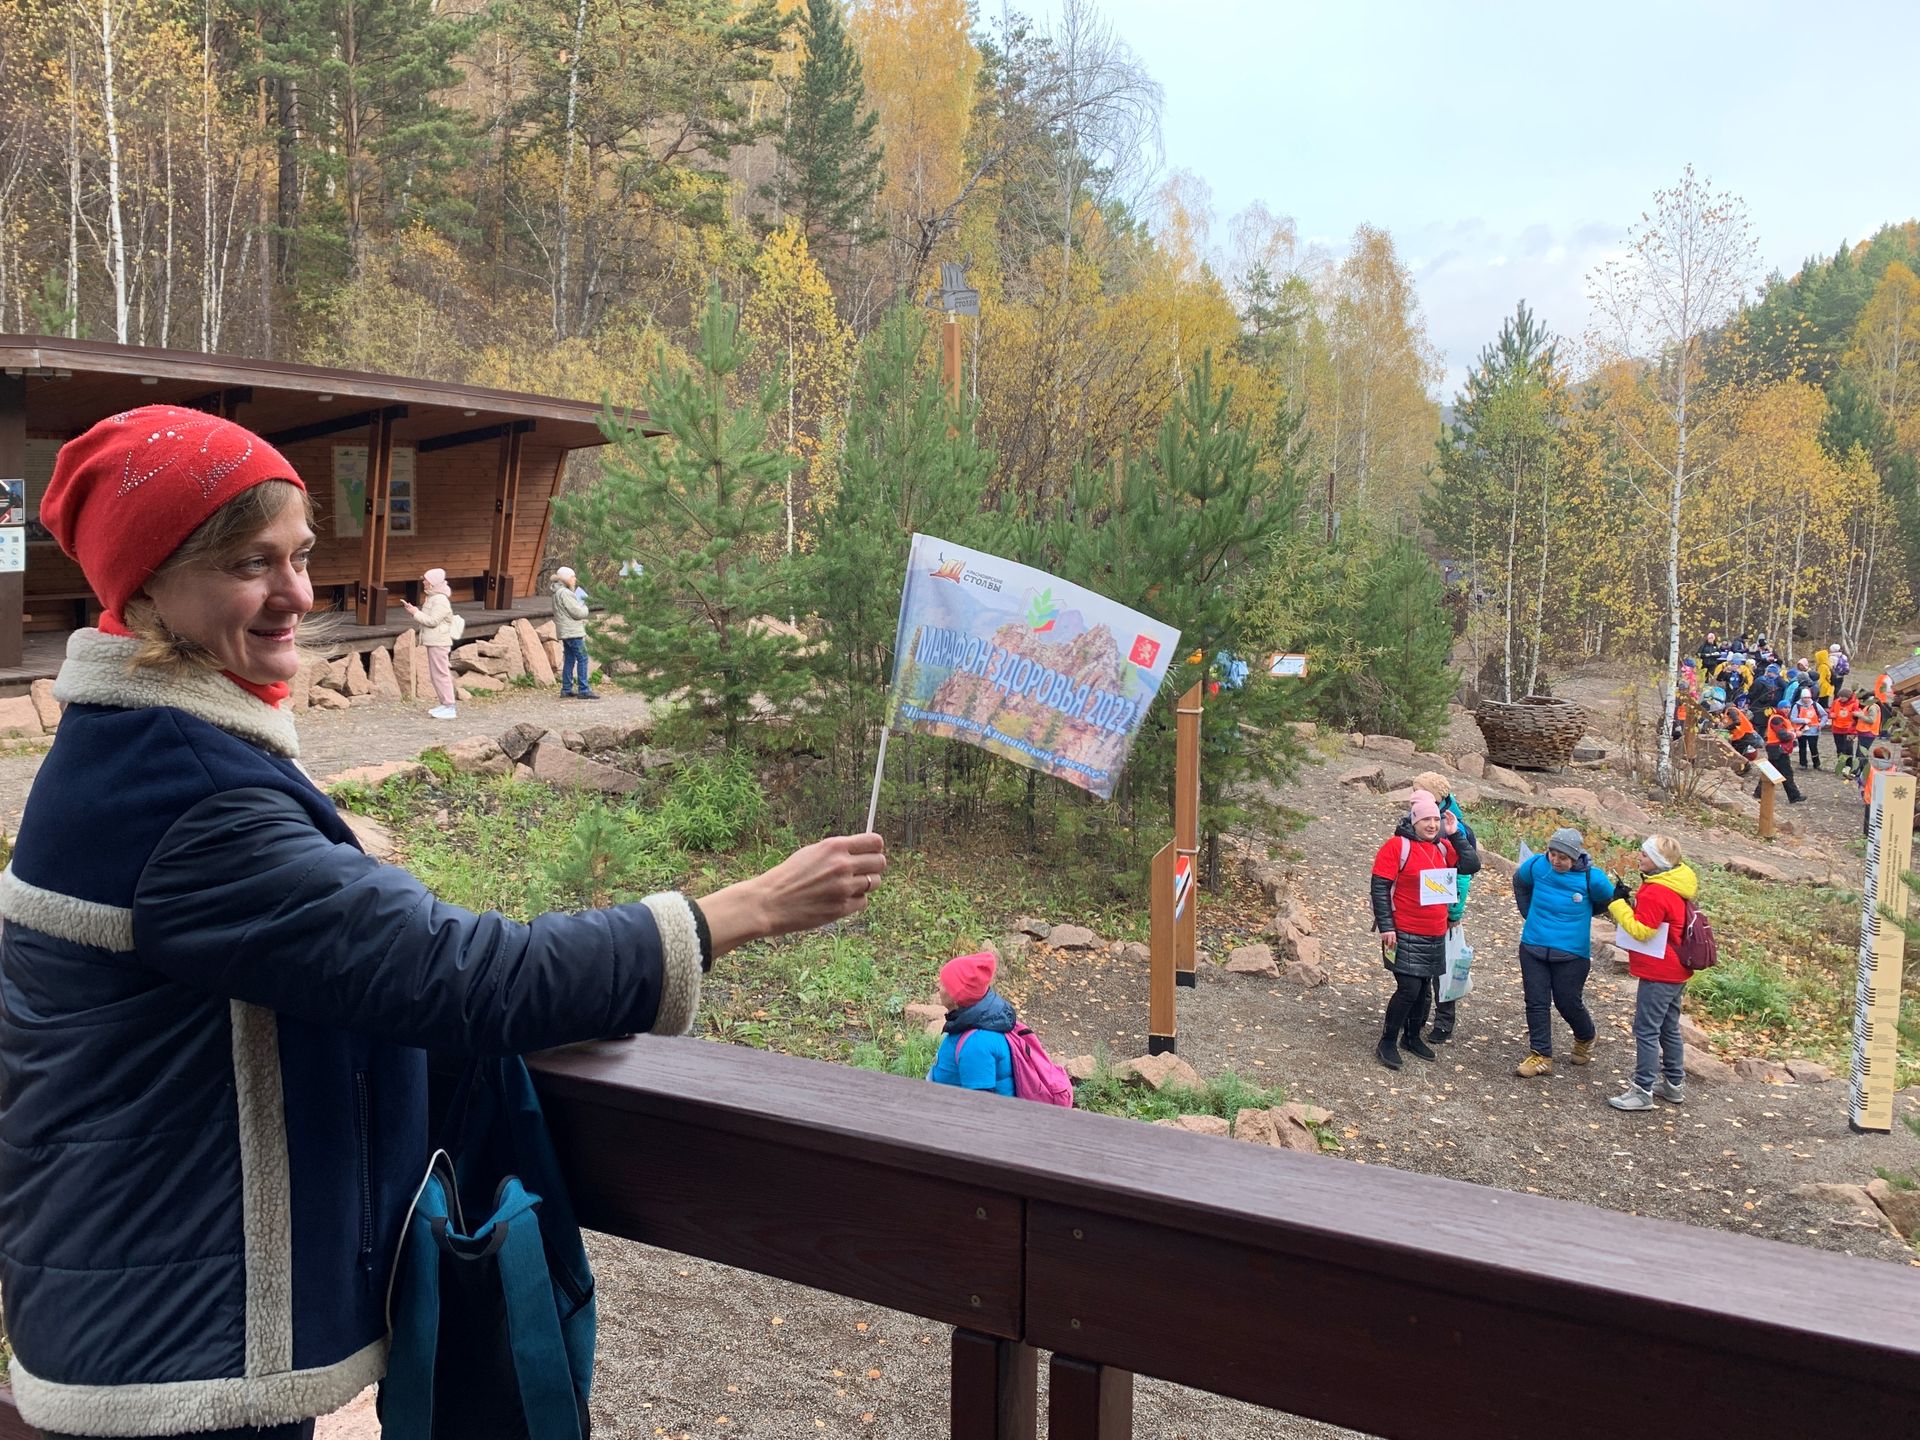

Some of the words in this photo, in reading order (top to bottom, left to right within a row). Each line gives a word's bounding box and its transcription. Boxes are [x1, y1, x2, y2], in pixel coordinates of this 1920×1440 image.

[963, 574, 1002, 593] СТОЛБЫ
[915, 625, 989, 677] МАРАФОН
[990, 648, 1090, 719] ЗДОРОВЬЯ
[1085, 689, 1137, 735] 2022
[982, 724, 1054, 761] Китайской
